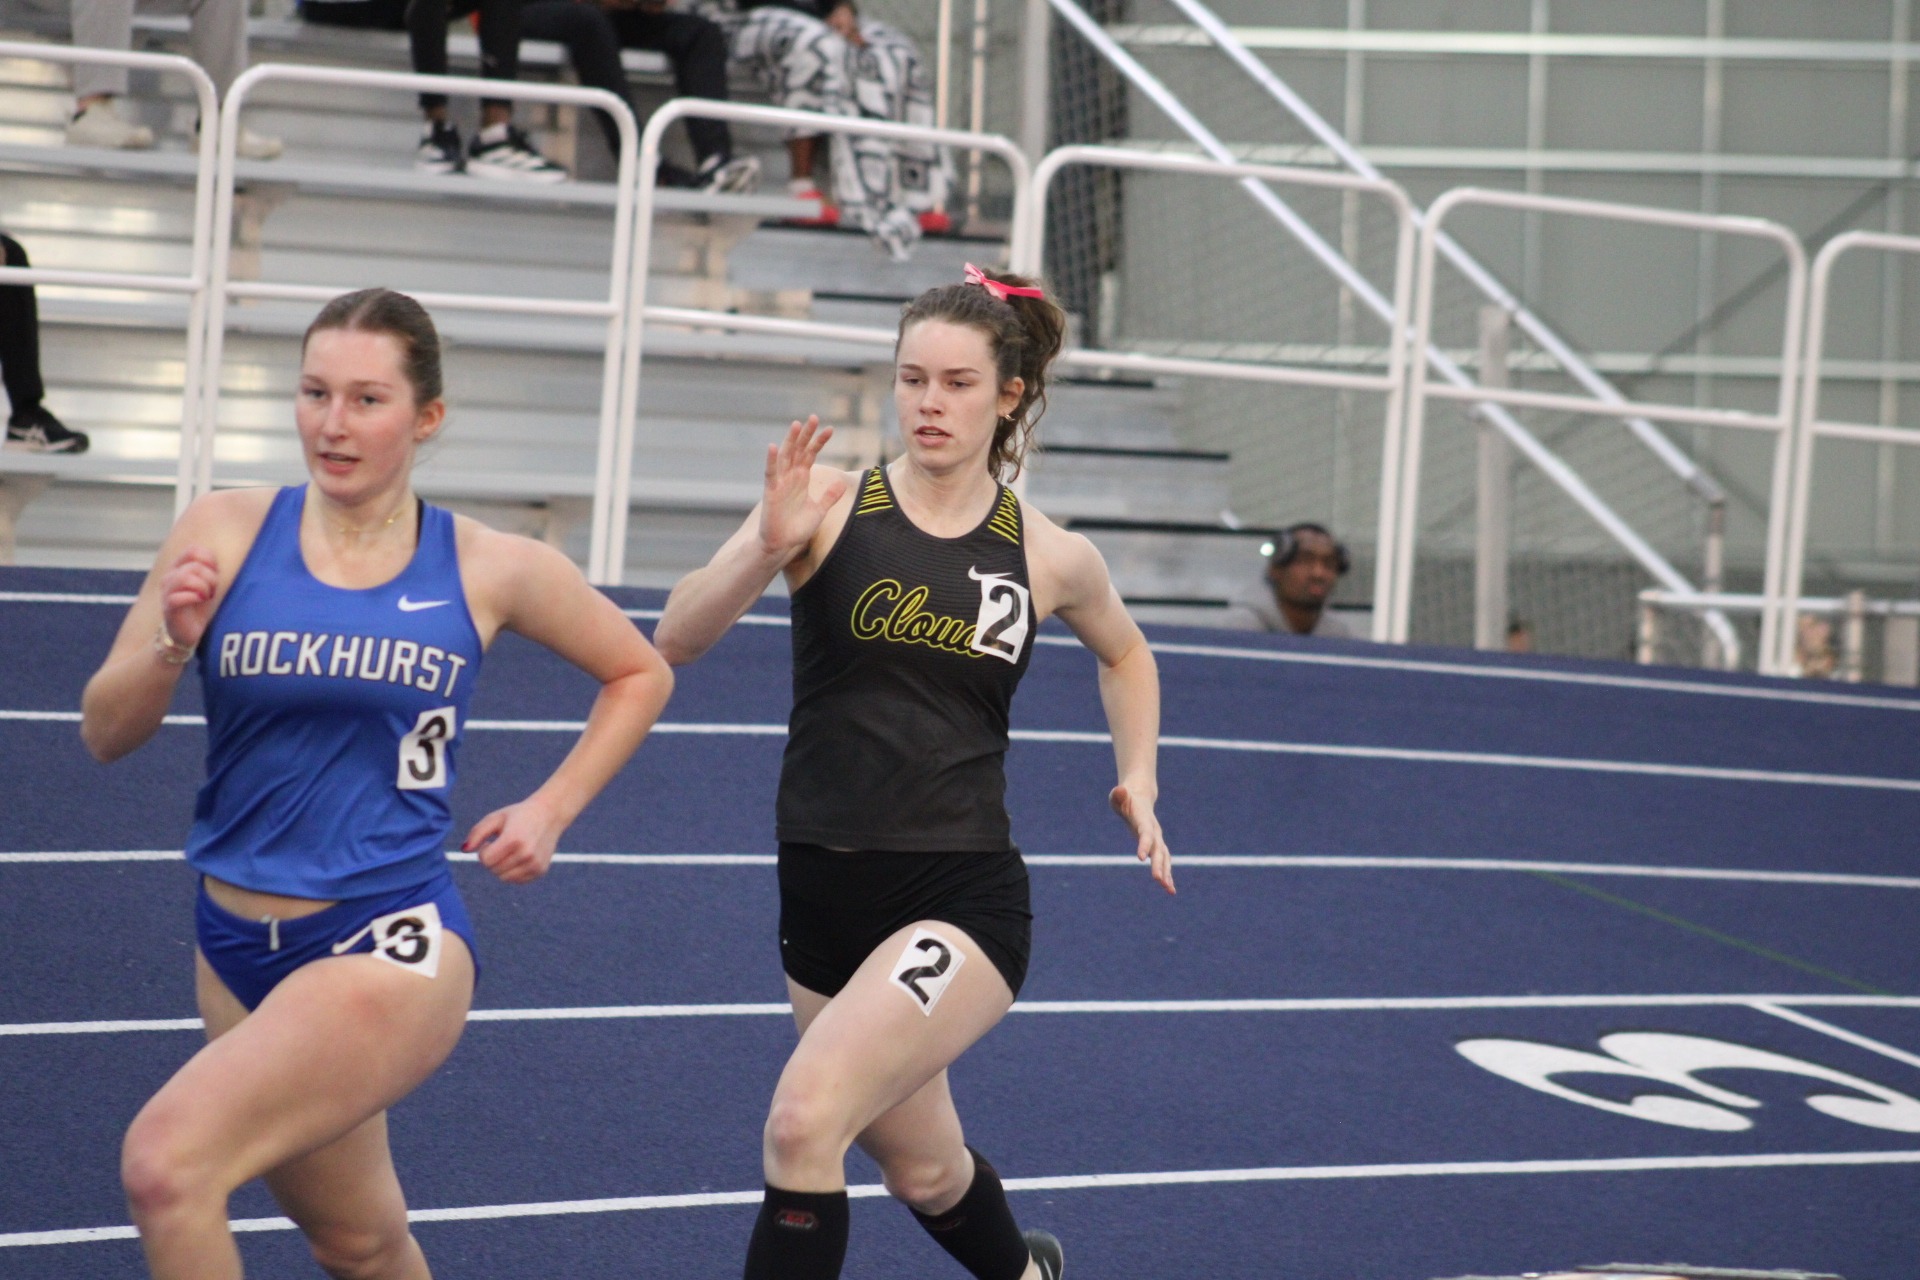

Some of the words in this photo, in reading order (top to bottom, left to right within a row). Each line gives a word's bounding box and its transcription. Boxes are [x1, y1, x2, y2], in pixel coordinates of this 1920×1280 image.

[979, 584, 1021, 656] 2
[219, 631, 467, 698] ROCKHURST
[407, 715, 447, 781] 3
[385, 916, 430, 964] 3
[897, 938, 952, 1006] 2
